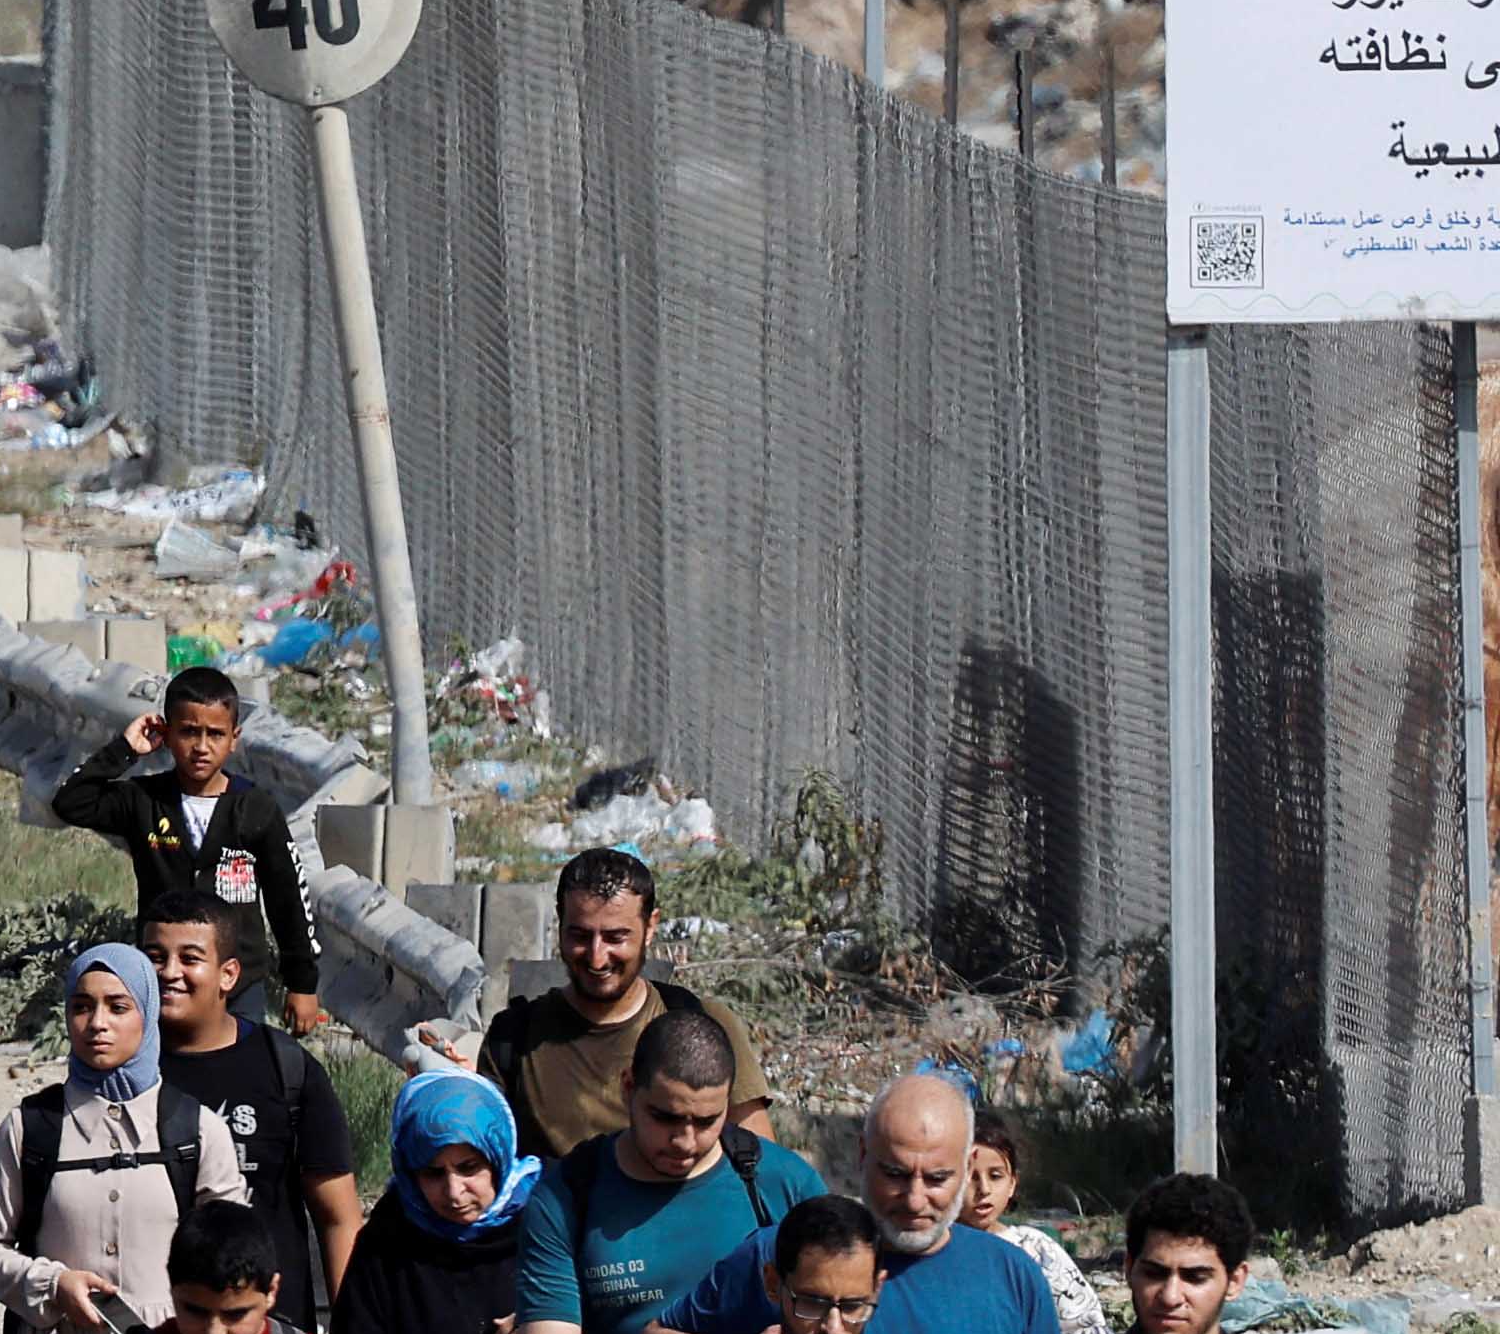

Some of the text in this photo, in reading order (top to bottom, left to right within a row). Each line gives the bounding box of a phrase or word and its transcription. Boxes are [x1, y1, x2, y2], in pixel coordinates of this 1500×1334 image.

[1318, 27, 1447, 72] نظافته
[1388, 120, 1500, 179] بيعية
[628, 1258, 646, 1273] 03
[627, 1288, 665, 1304] WEAR
